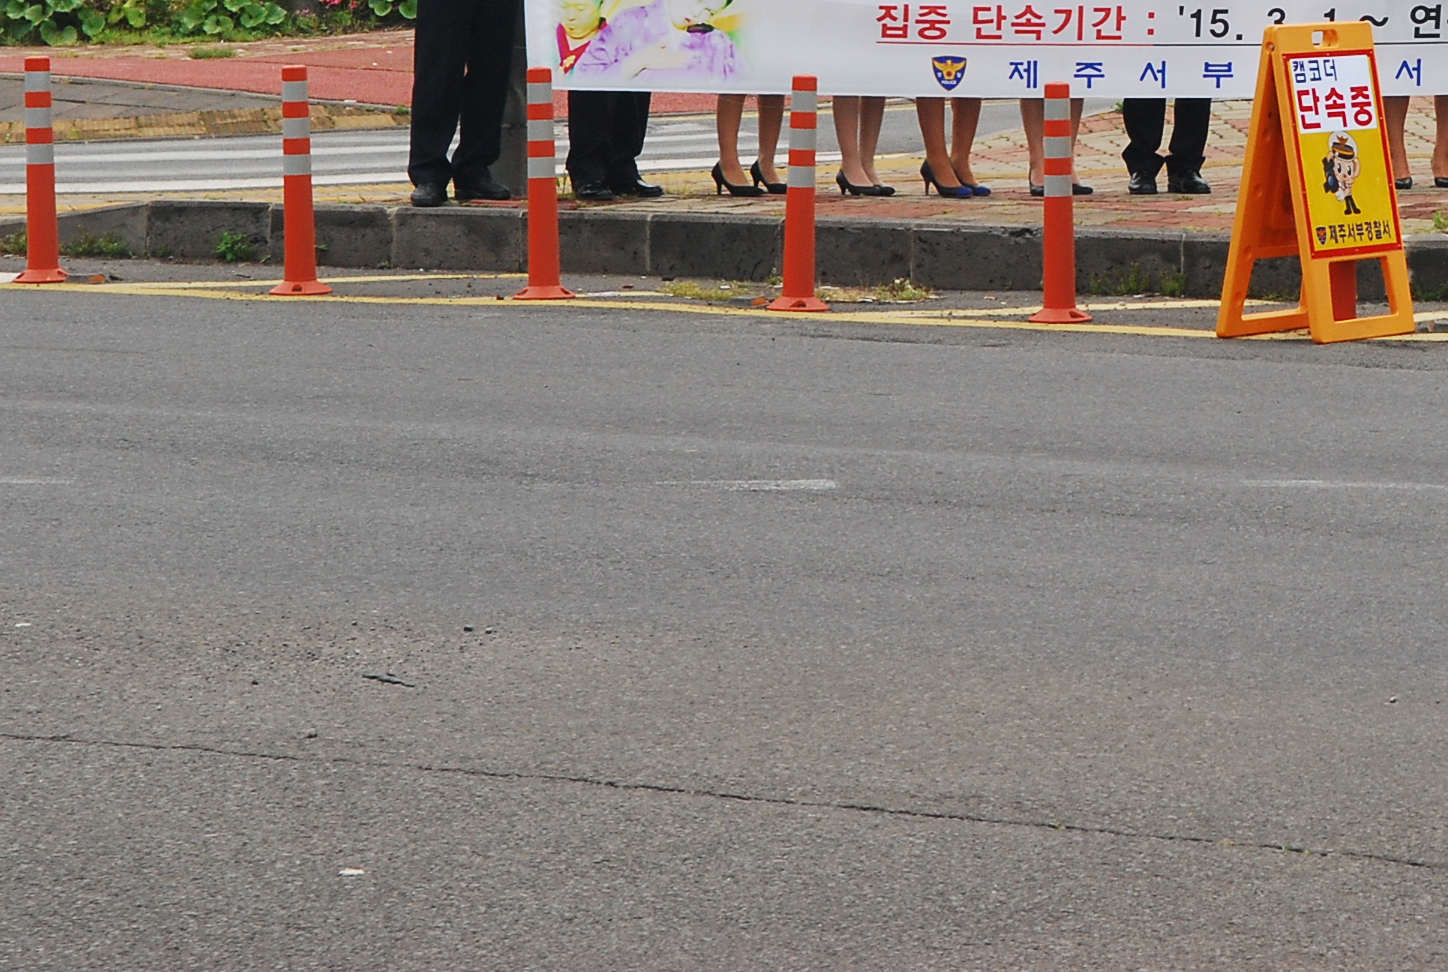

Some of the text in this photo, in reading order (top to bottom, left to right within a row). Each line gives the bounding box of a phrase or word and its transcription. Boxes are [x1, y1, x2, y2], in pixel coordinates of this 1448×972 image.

[876, 4, 951, 41] 집중
[971, 4, 1127, 41] 단속기간
[1291, 58, 1338, 83] 캠코더
[1296, 85, 1373, 130] 단속중
[1329, 219, 1392, 245] 제주서부경찰서
